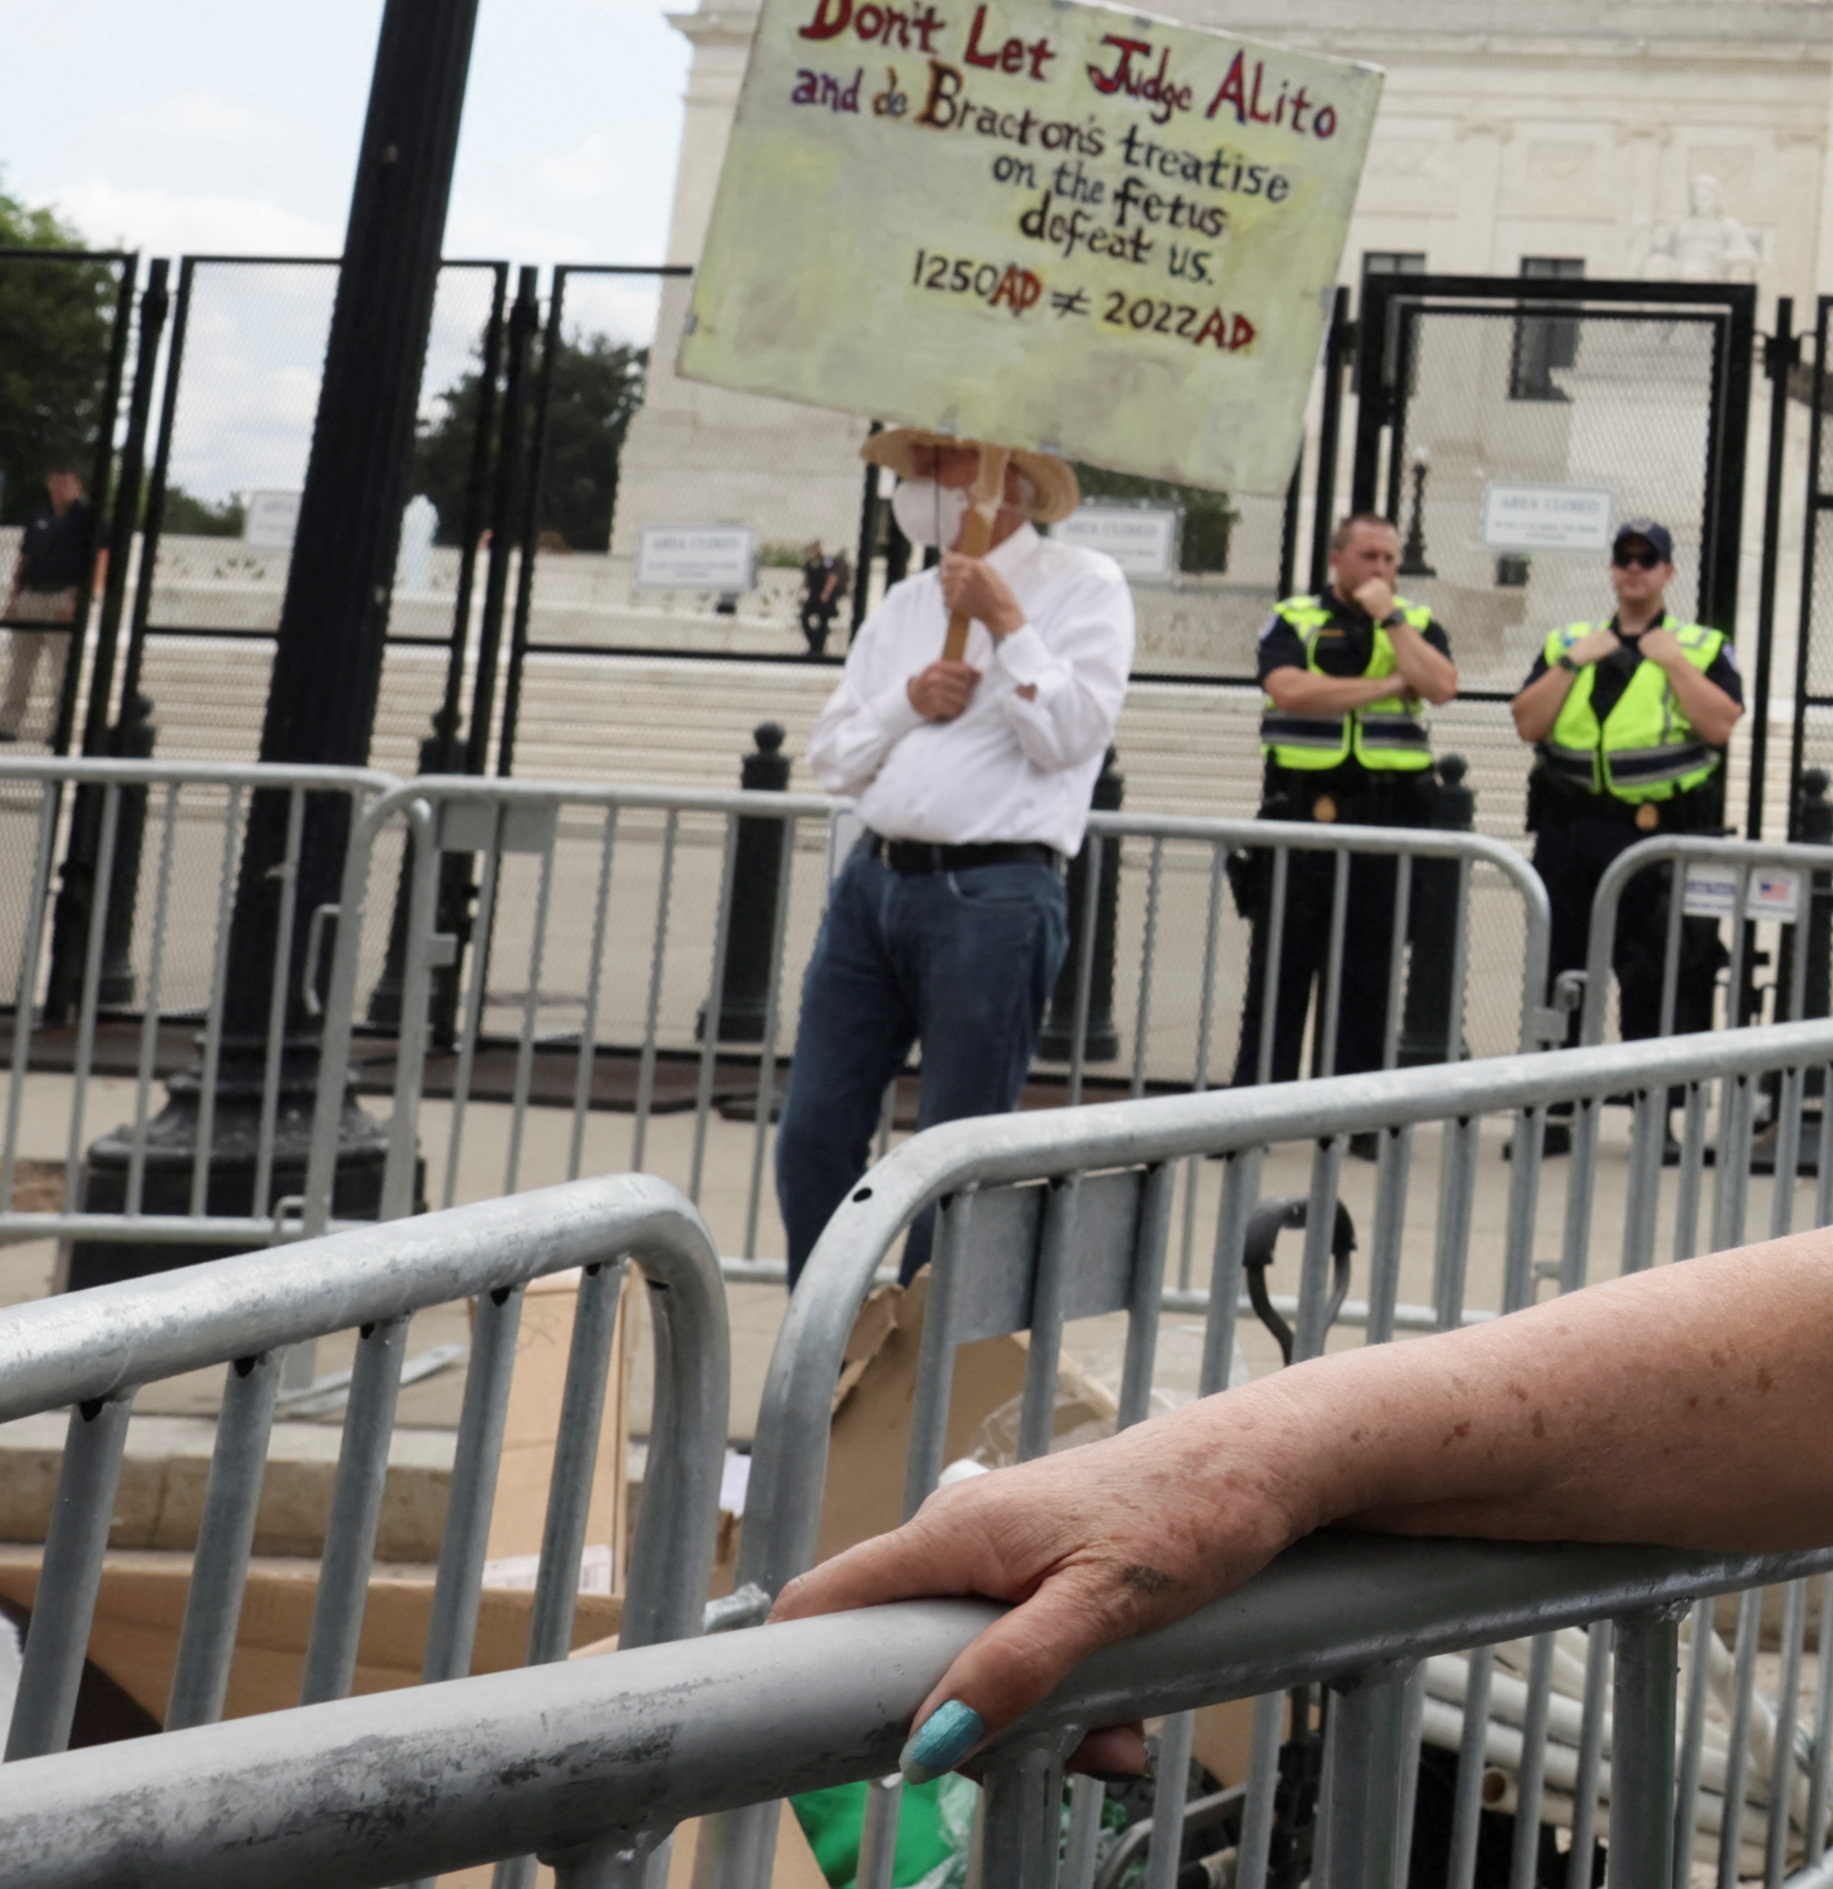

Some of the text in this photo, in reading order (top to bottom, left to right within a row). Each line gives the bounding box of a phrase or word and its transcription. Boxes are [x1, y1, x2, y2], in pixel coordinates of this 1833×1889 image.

[964, 3, 1056, 81] Let
[1087, 34, 1193, 125] Judge
[791, 66, 863, 113] and
[914, 58, 1106, 156] Bracton's
[1117, 123, 1291, 204] treatise
[993, 155, 1229, 238] on the fetus
[1019, 189, 1215, 286] defeat us.
[913, 249, 1044, 318] 1250AD
[1103, 290, 1256, 351] 2022AD
